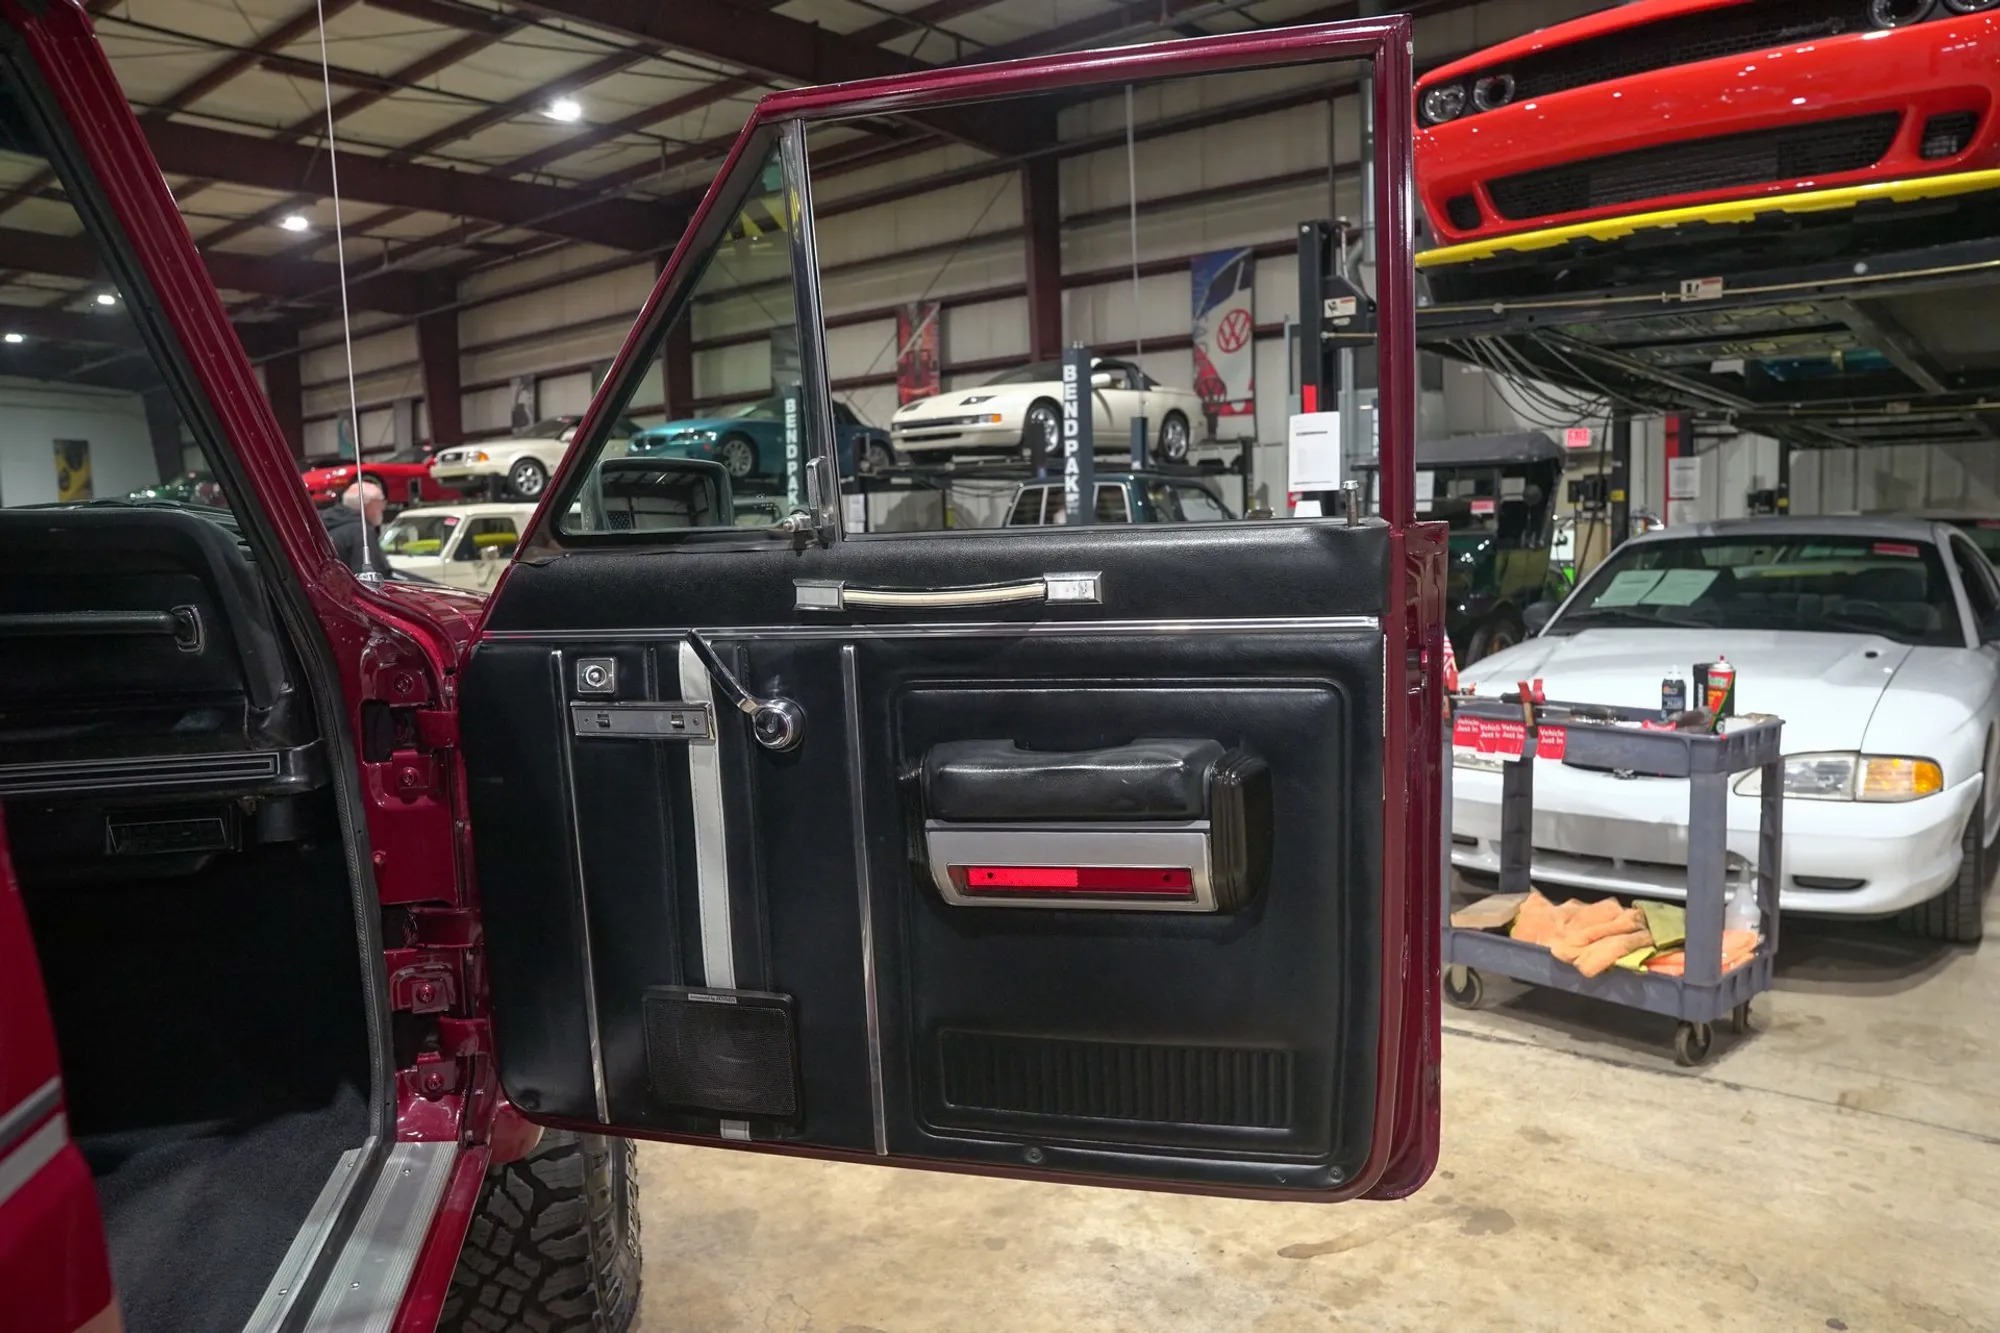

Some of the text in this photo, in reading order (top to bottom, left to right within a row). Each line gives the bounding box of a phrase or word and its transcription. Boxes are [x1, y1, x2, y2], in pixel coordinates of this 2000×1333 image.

[1063, 364, 1079, 492] BENDPAK
[785, 398, 799, 505] BENDPAK
[1501, 723, 1525, 732] Vehicle
[1502, 731, 1516, 739] Just
[1540, 728, 1564, 737] Vehicle
